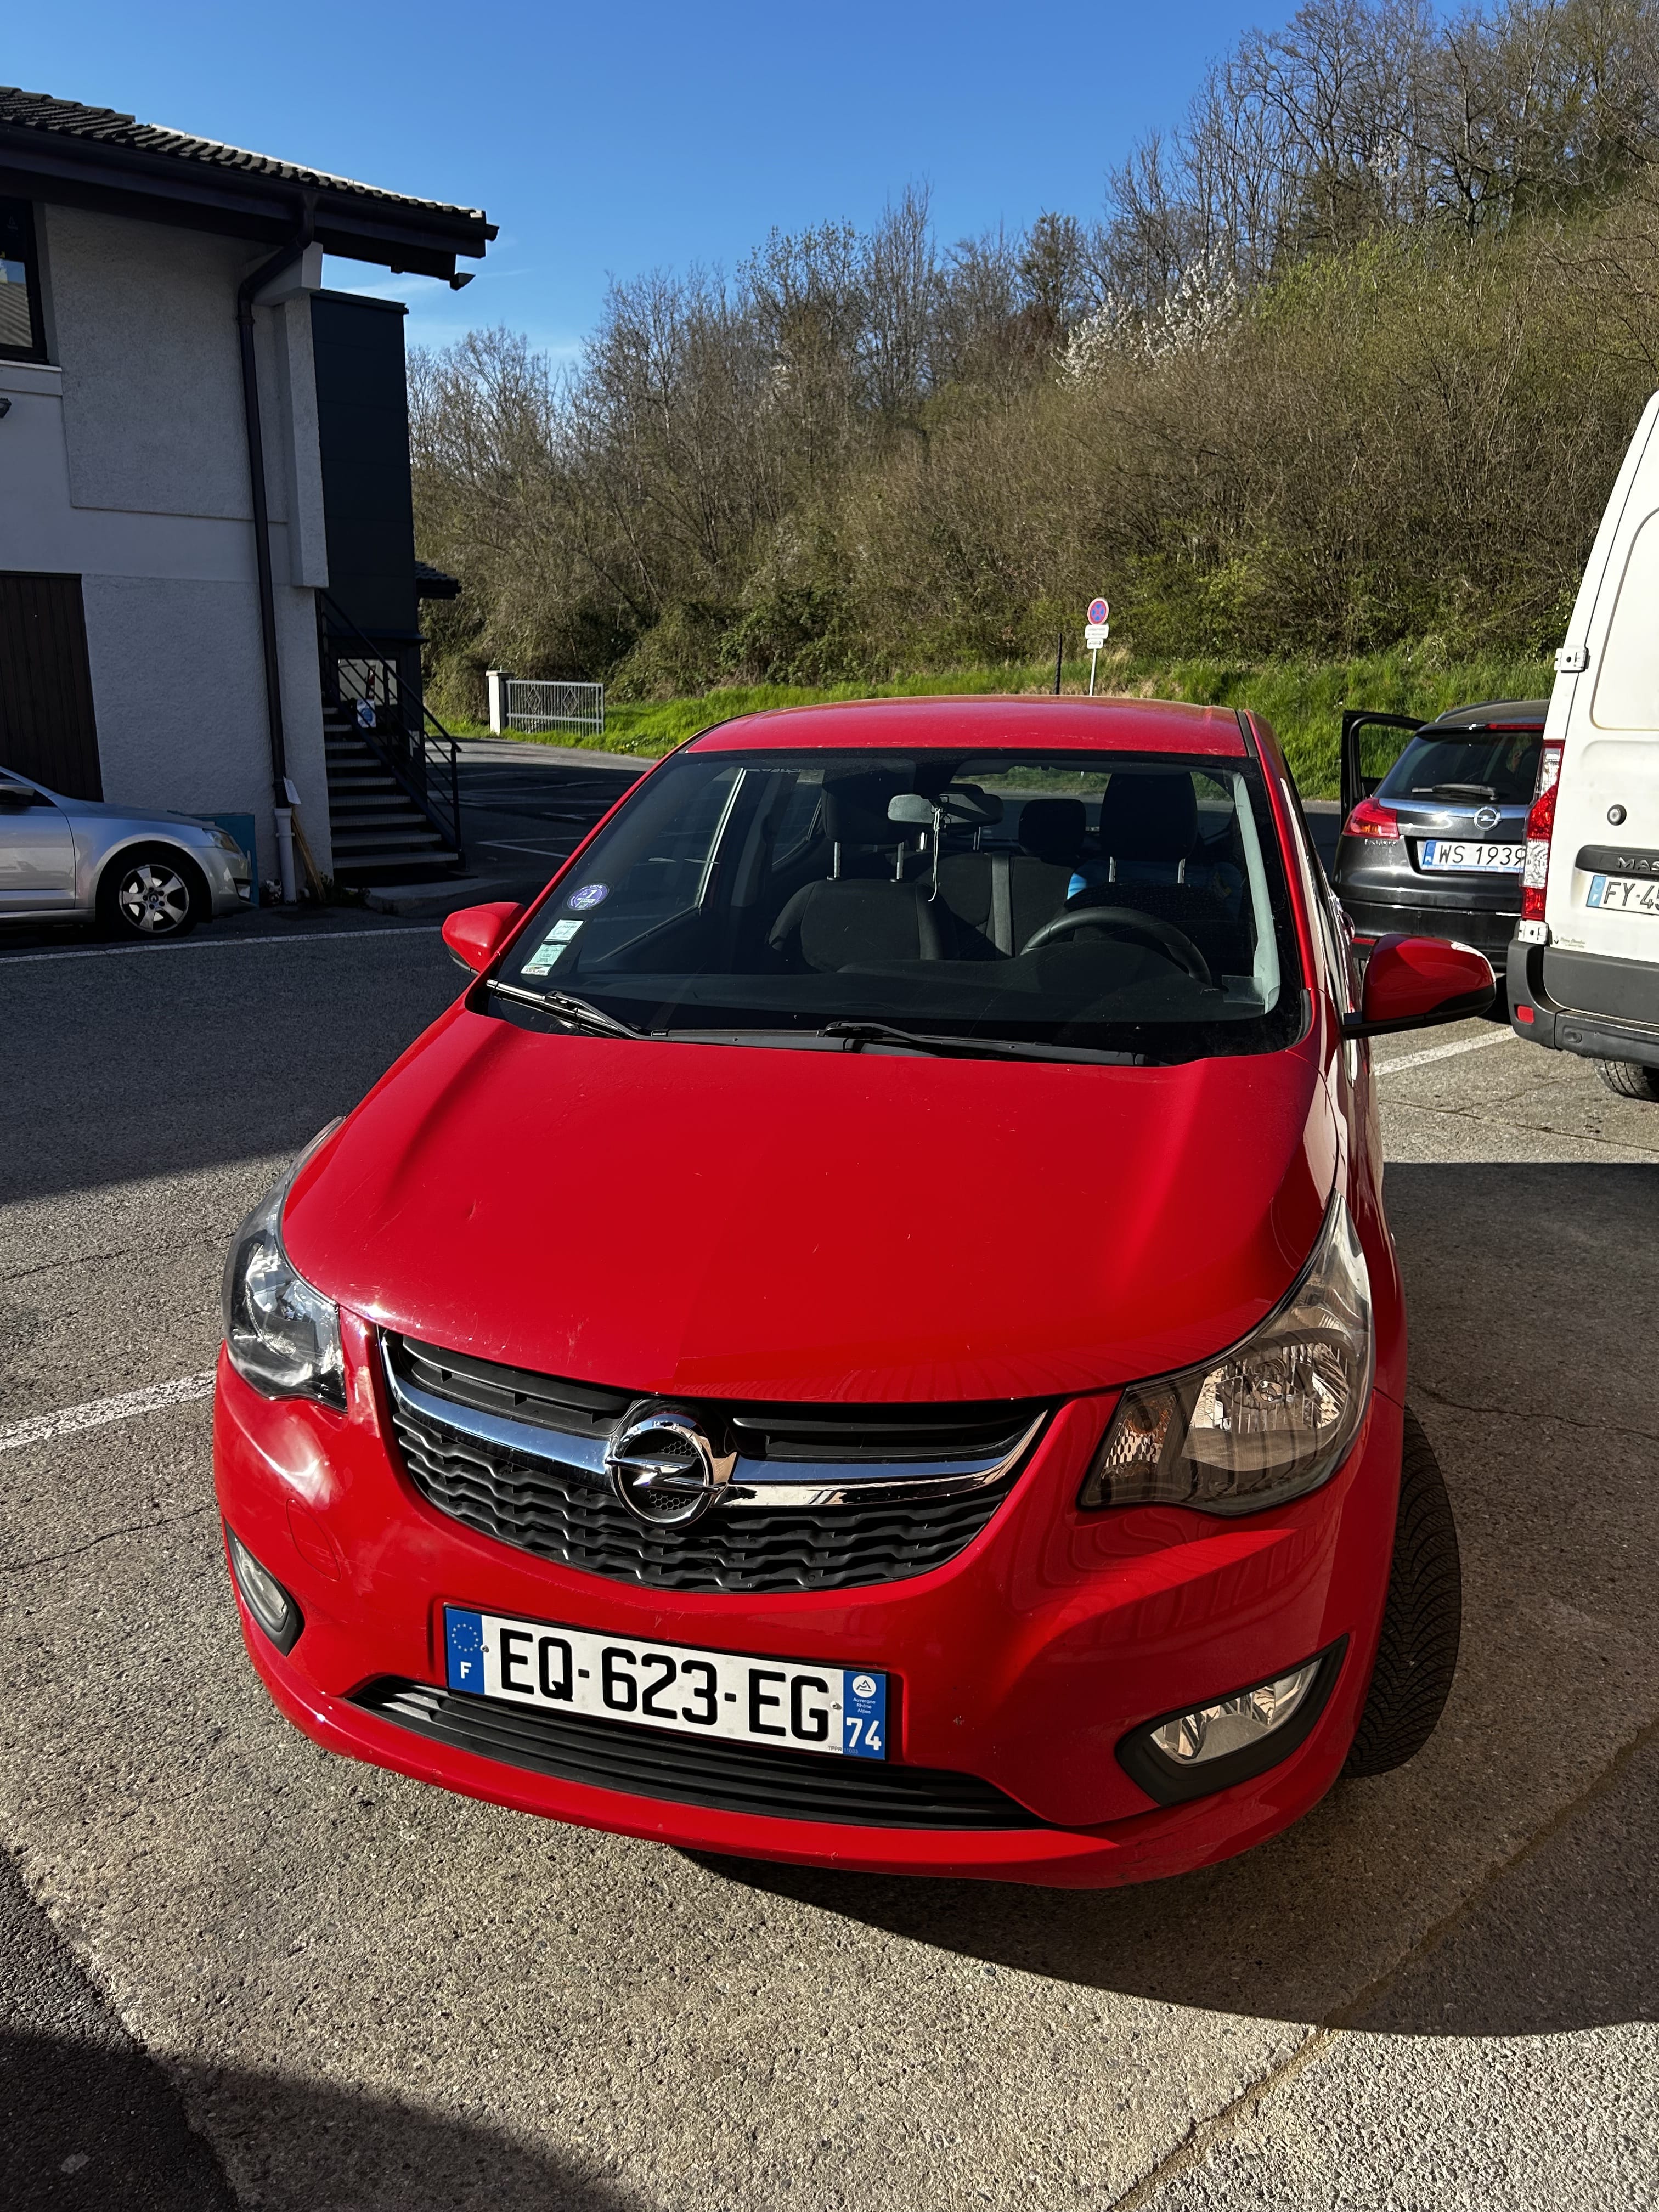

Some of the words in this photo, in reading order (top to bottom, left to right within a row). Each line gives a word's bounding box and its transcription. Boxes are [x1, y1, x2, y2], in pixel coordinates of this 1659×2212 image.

[1439, 845, 1465, 864] WS
[460, 1661, 472, 1679] F
[500, 1628, 829, 1741] EQ-623-EG
[847, 1717, 882, 1750] 74
